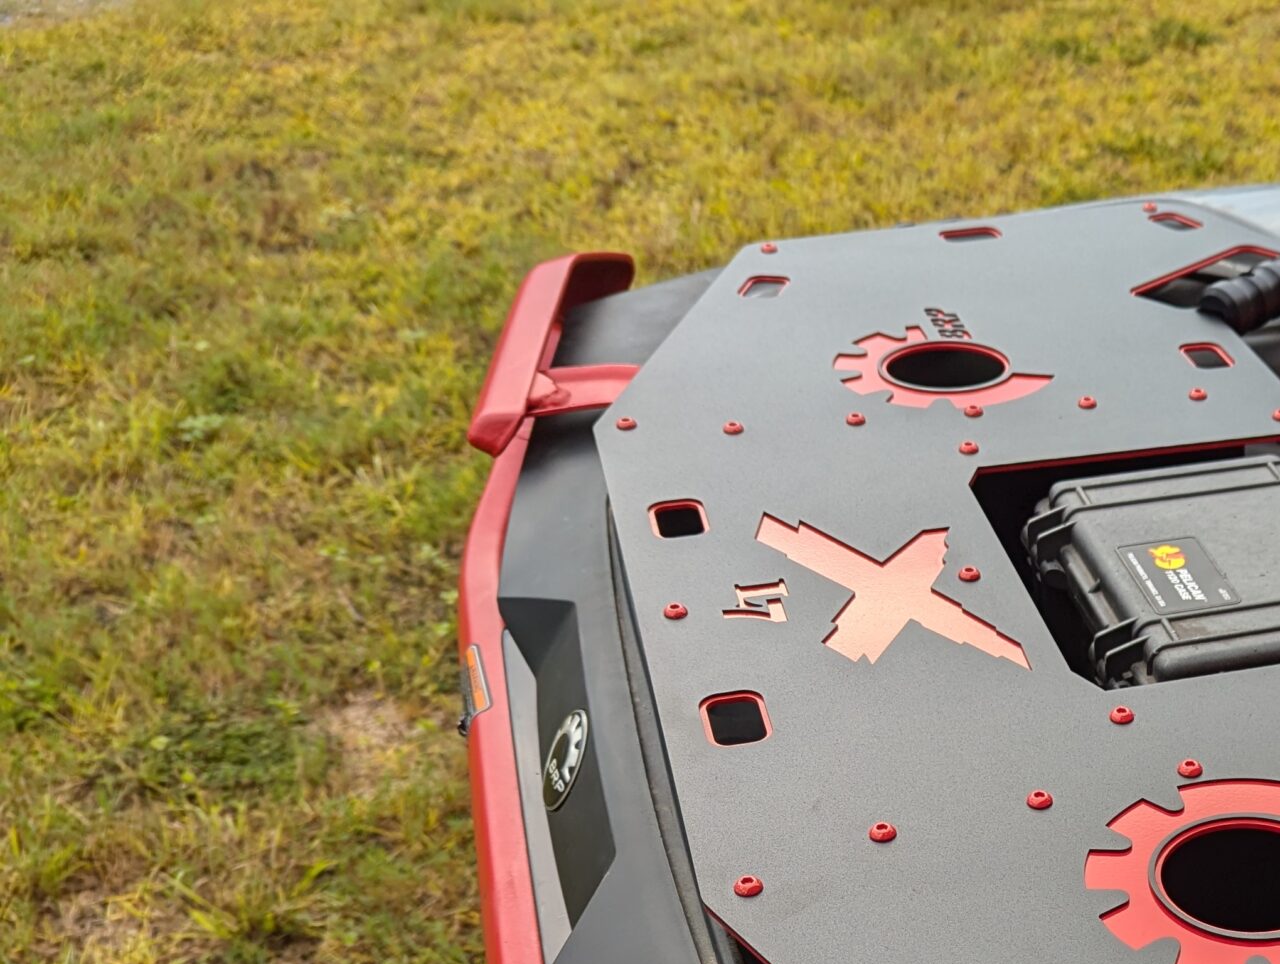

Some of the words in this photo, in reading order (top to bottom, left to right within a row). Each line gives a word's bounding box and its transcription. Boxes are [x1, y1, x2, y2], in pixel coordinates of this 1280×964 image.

[924, 308, 972, 340] BRP
[1174, 583, 1192, 600] CASE
[1175, 568, 1206, 600] PELICAN
[549, 758, 565, 792] BRP
